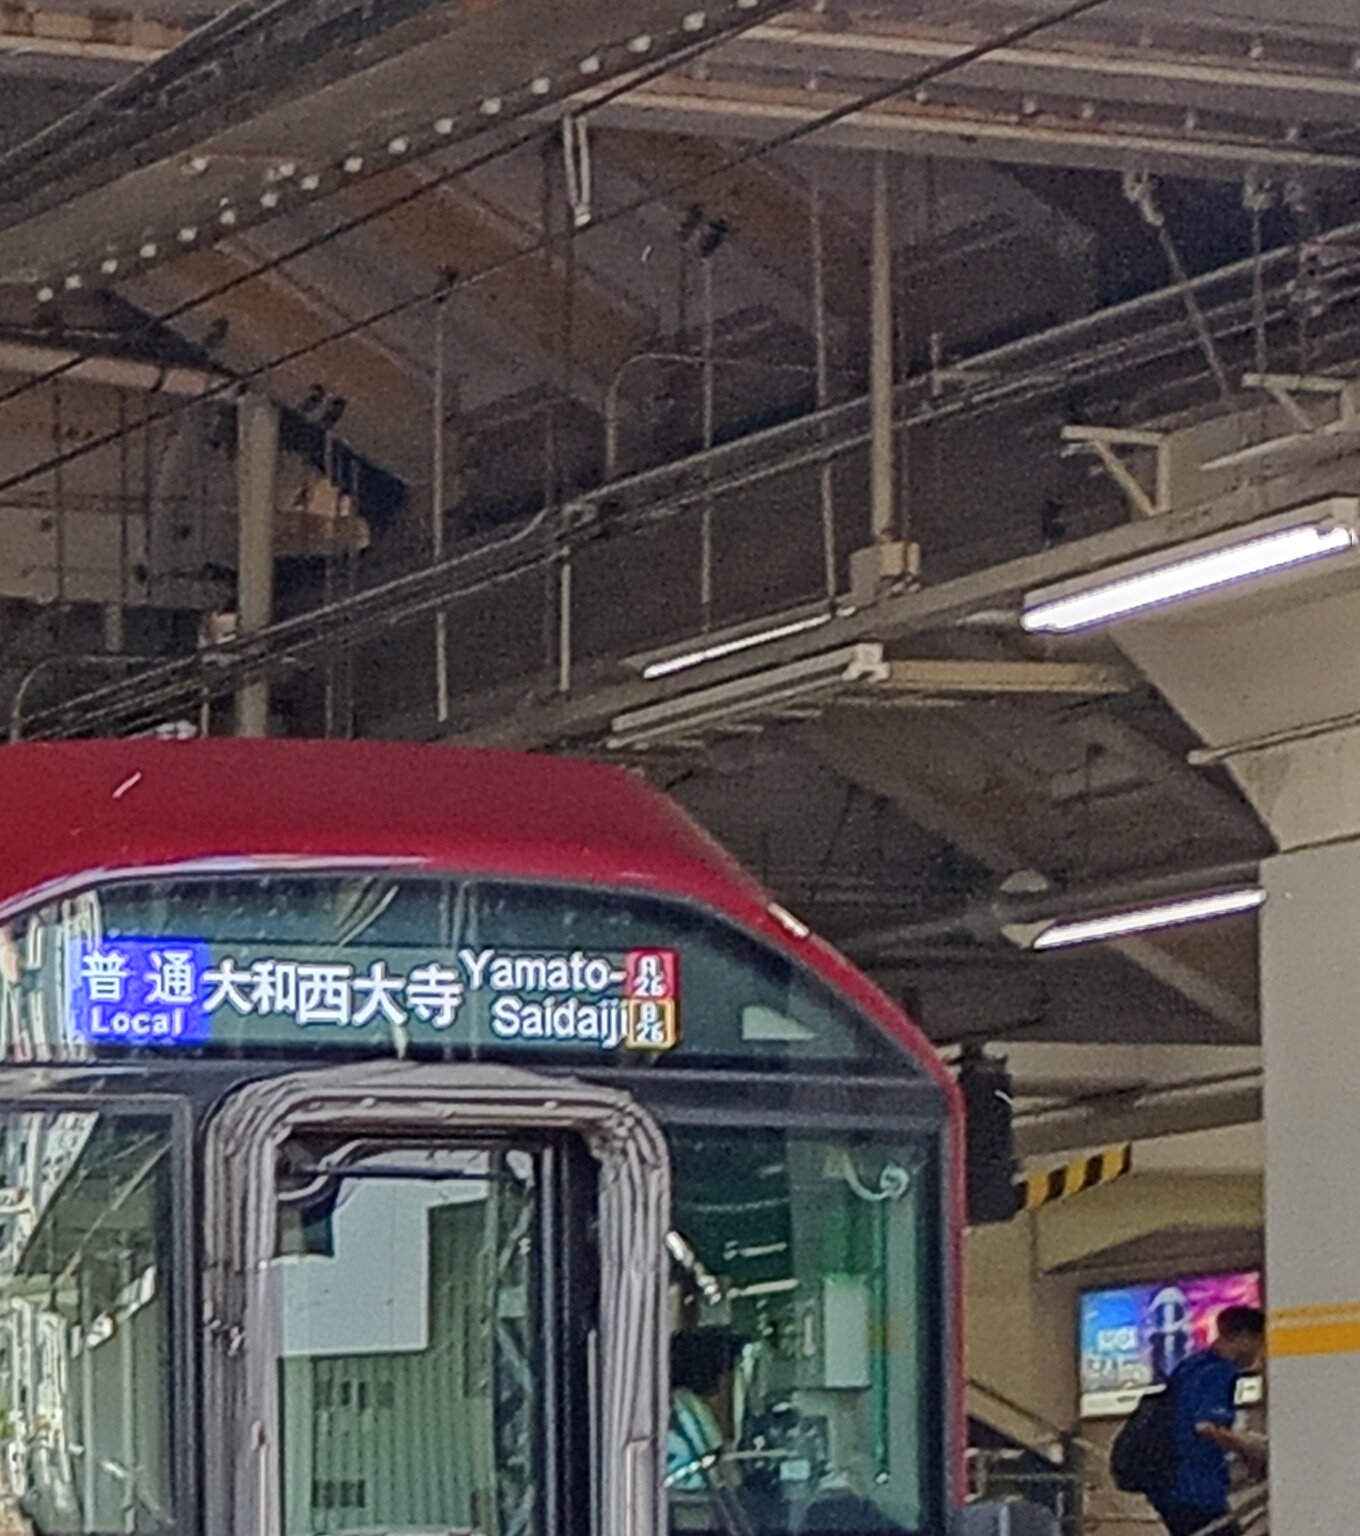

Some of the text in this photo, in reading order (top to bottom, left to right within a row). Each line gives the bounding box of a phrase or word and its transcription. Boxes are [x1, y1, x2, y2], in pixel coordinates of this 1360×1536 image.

[81, 950, 195, 1004] 普通
[201, 957, 463, 1028] 大和西大寺
[459, 949, 626, 992] Yamato-
[90, 1006, 184, 1036] Local
[492, 995, 629, 1049] Saidaiji
